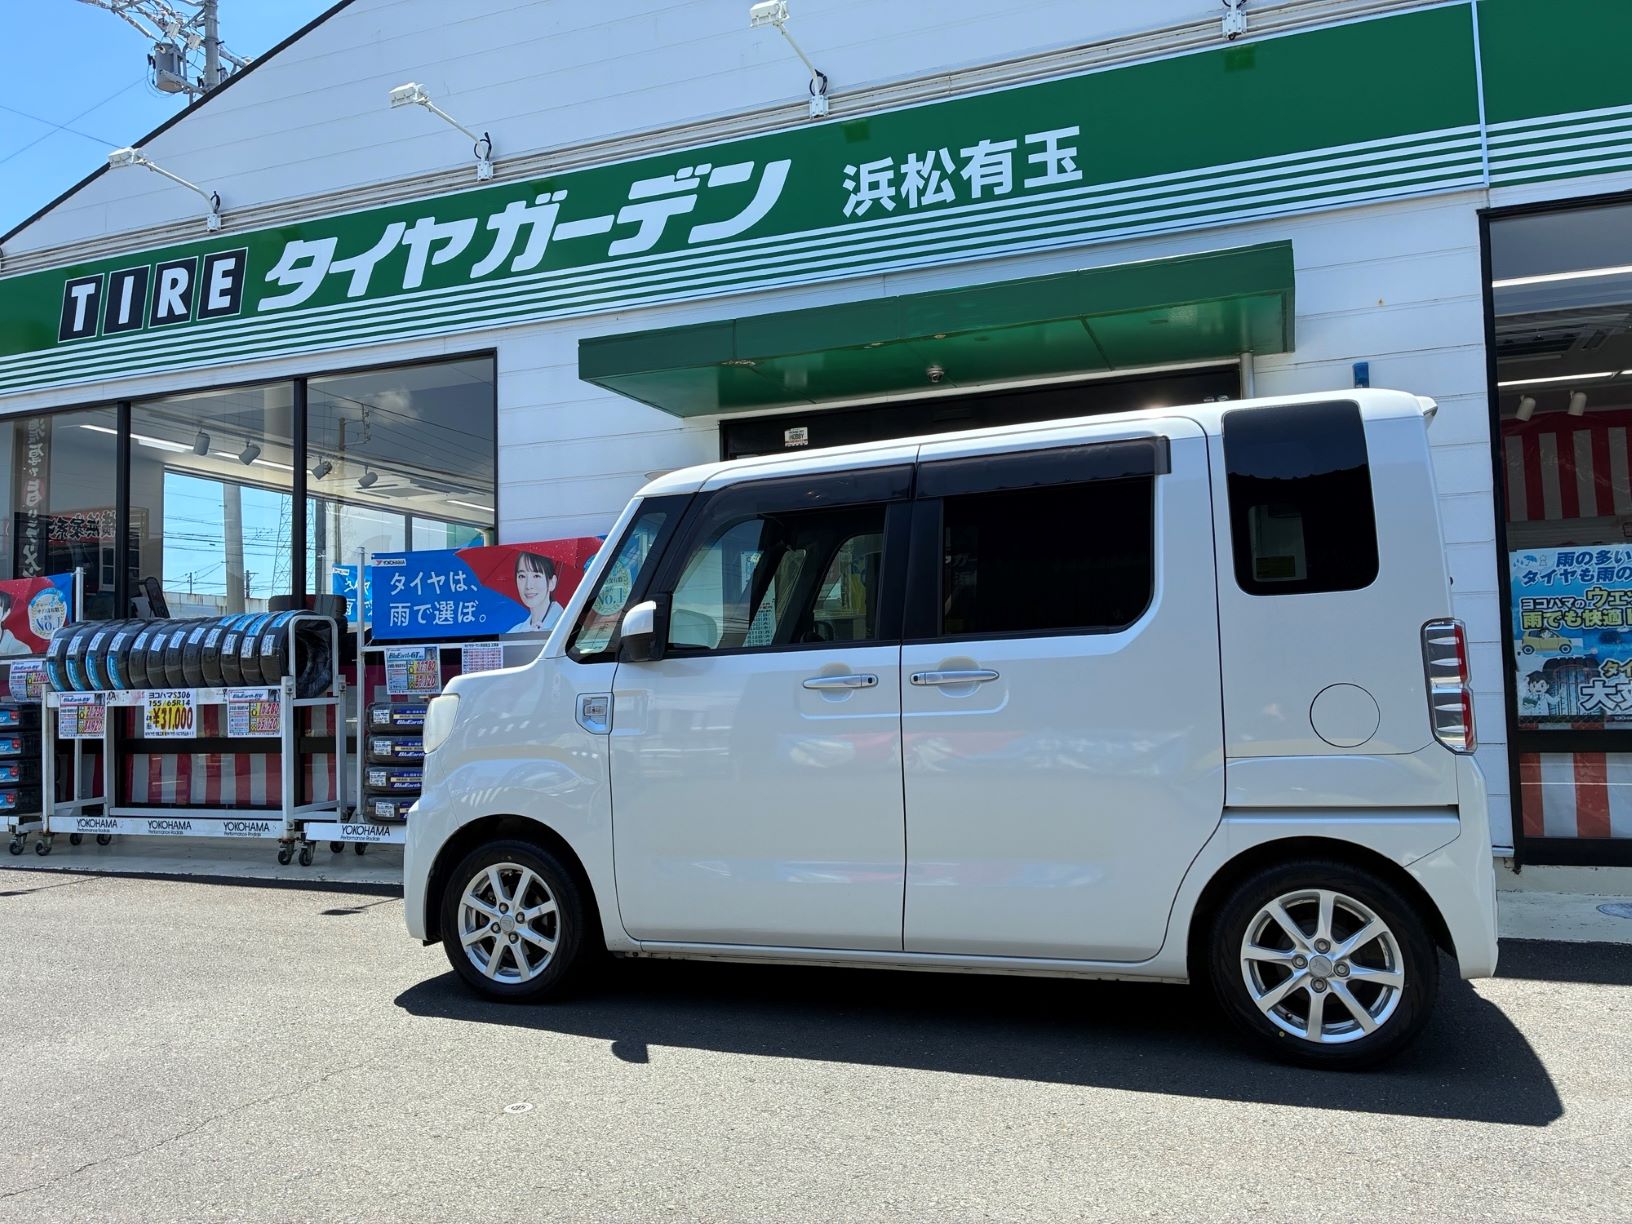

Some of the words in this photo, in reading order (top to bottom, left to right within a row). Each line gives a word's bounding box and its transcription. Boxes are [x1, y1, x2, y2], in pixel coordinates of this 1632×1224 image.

[71, 257, 236, 332] TIRE
[258, 158, 792, 311] タイヤガーデン
[842, 125, 1083, 218] 浜松有玉
[1556, 549, 1632, 567] 雨の多い
[390, 570, 478, 595] タイヤは、
[1522, 566, 1632, 585] タイヤも雨の
[389, 601, 487, 627] 雨で選ぼ。
[149, 691, 191, 699] ヨコハマS306
[149, 699, 191, 707] 155/65R14
[153, 706, 193, 730] ¥31,000
[76, 818, 118, 828] YOKOHAMA
[148, 820, 192, 830] YOKOHAMA
[223, 821, 270, 832] YOKOHAMA
[341, 825, 391, 836] YOKOHAMA
